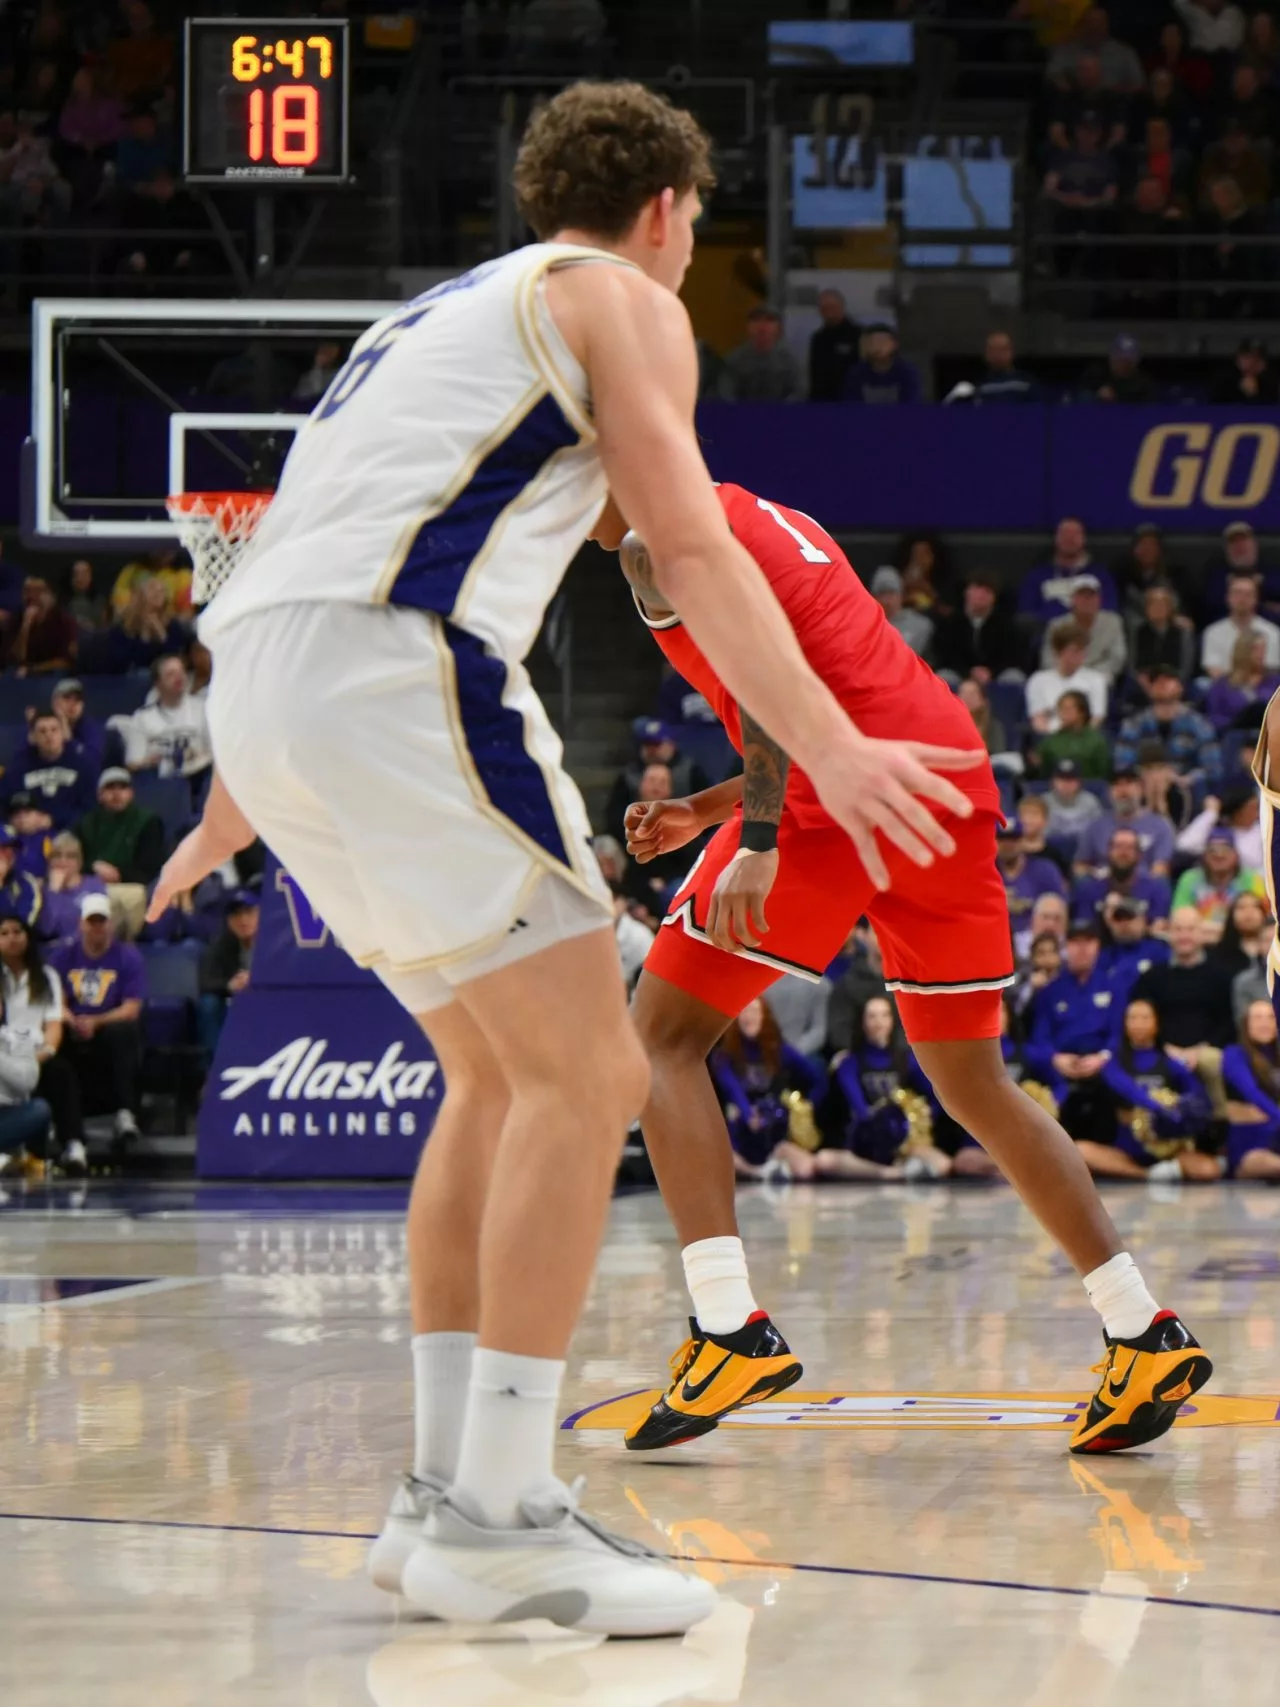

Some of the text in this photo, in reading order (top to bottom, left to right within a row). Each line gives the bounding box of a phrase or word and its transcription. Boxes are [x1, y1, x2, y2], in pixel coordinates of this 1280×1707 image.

[231, 36, 332, 82] 6:47
[248, 84, 318, 165] 18
[755, 497, 836, 564] 1
[219, 1036, 438, 1109] Alaska
[233, 1111, 417, 1137] AIRLINES
